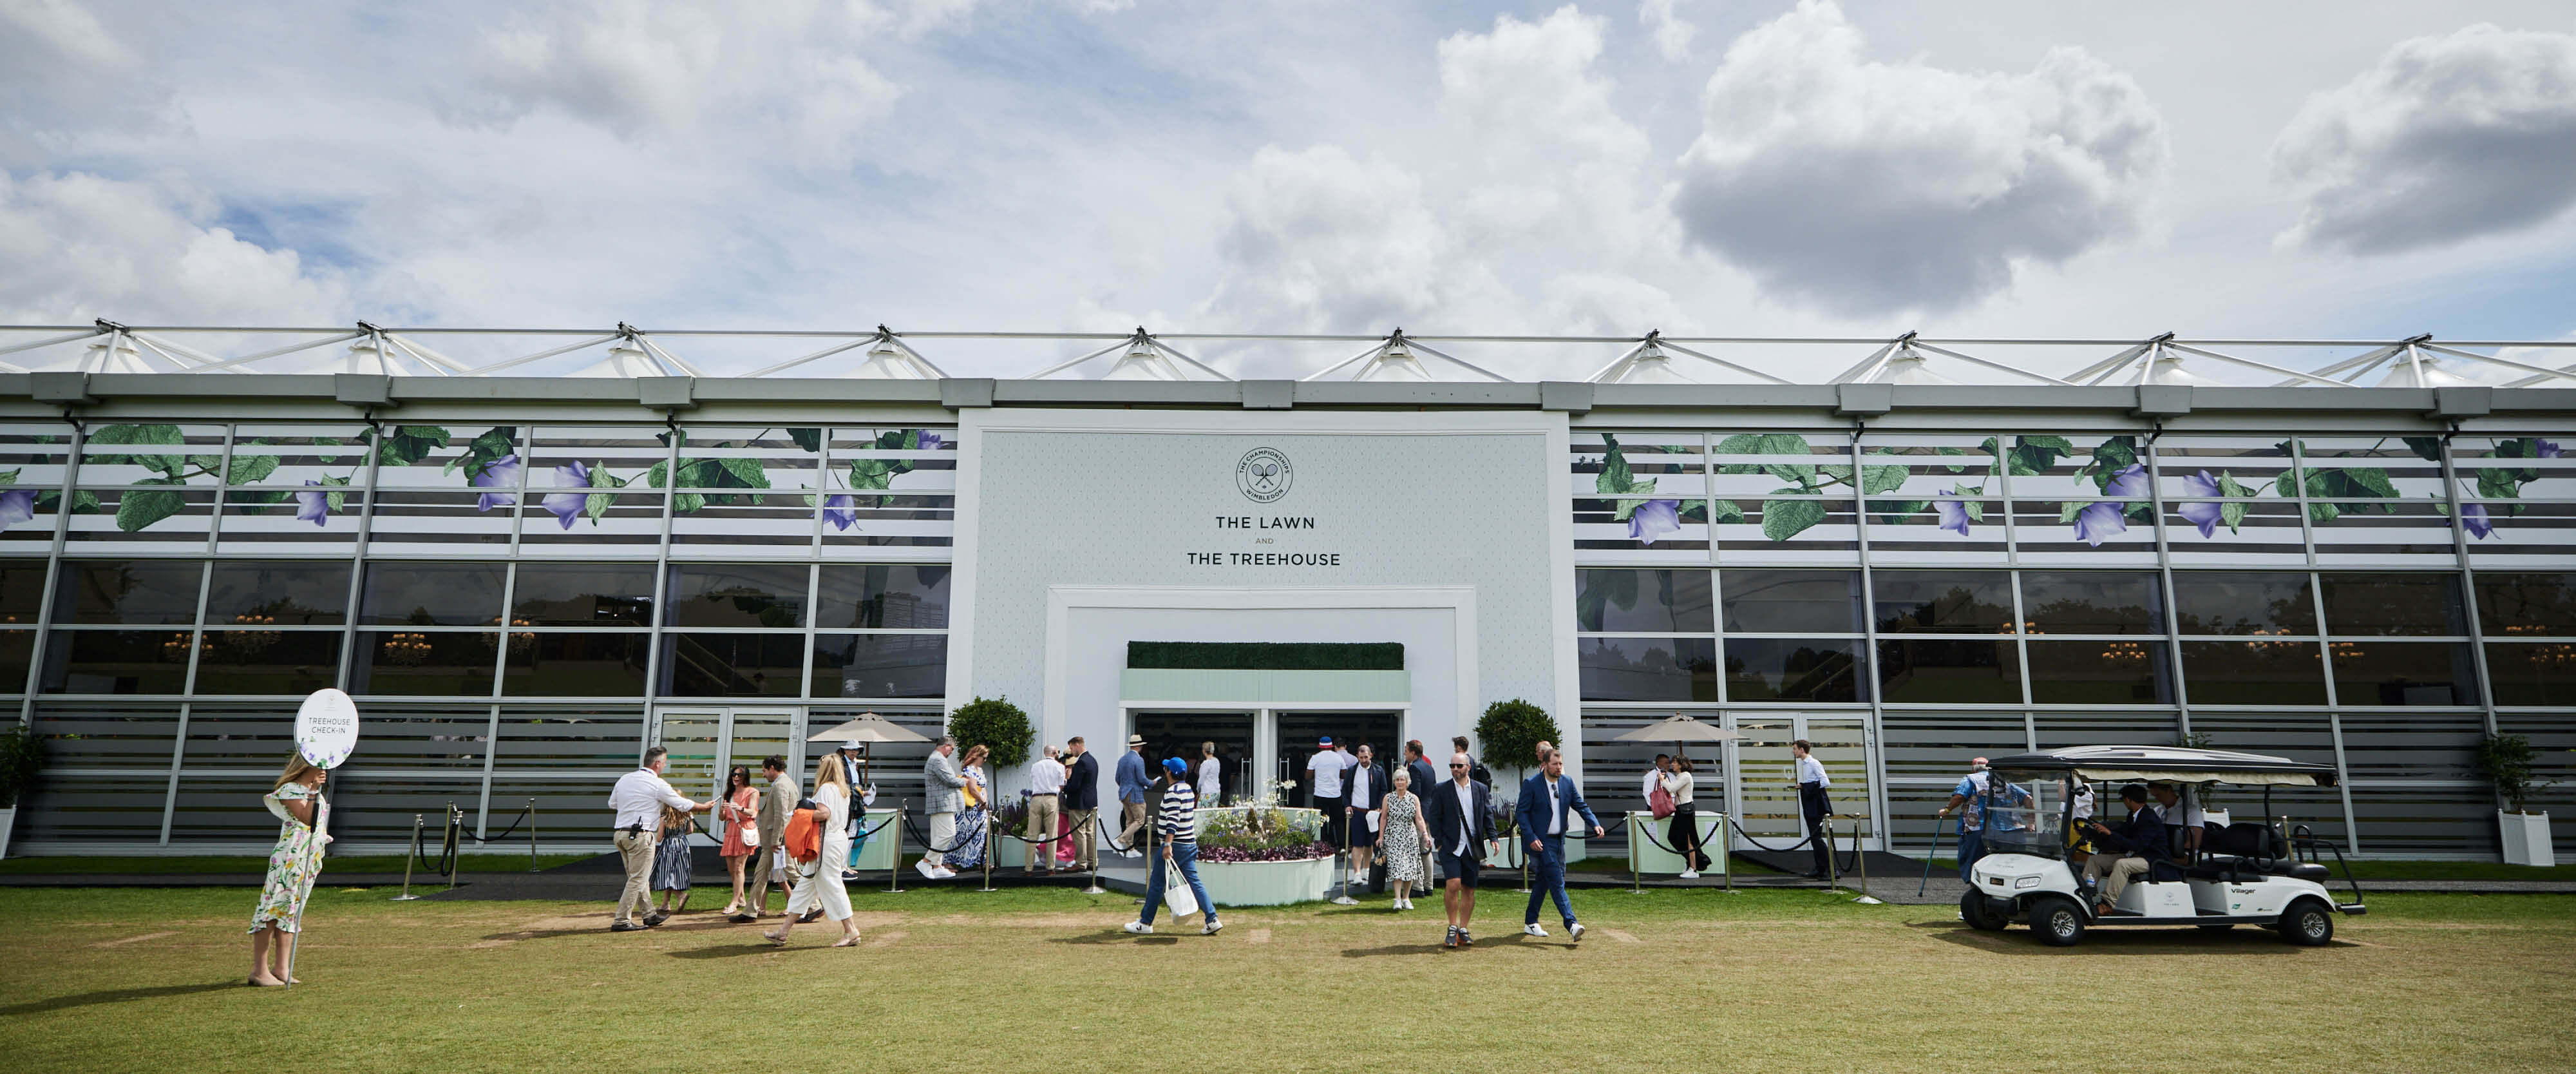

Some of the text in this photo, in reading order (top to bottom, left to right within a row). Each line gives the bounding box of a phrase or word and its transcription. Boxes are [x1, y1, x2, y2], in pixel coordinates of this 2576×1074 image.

[1246, 450, 1289, 474] CHAMPIONSHIPS
[1246, 488, 1283, 501] WIMBLEDON
[1216, 517, 1314, 529] THE LAWN
[1188, 553, 1340, 566] THE TREEHOUSE
[309, 717, 350, 725] TREEHOUSE
